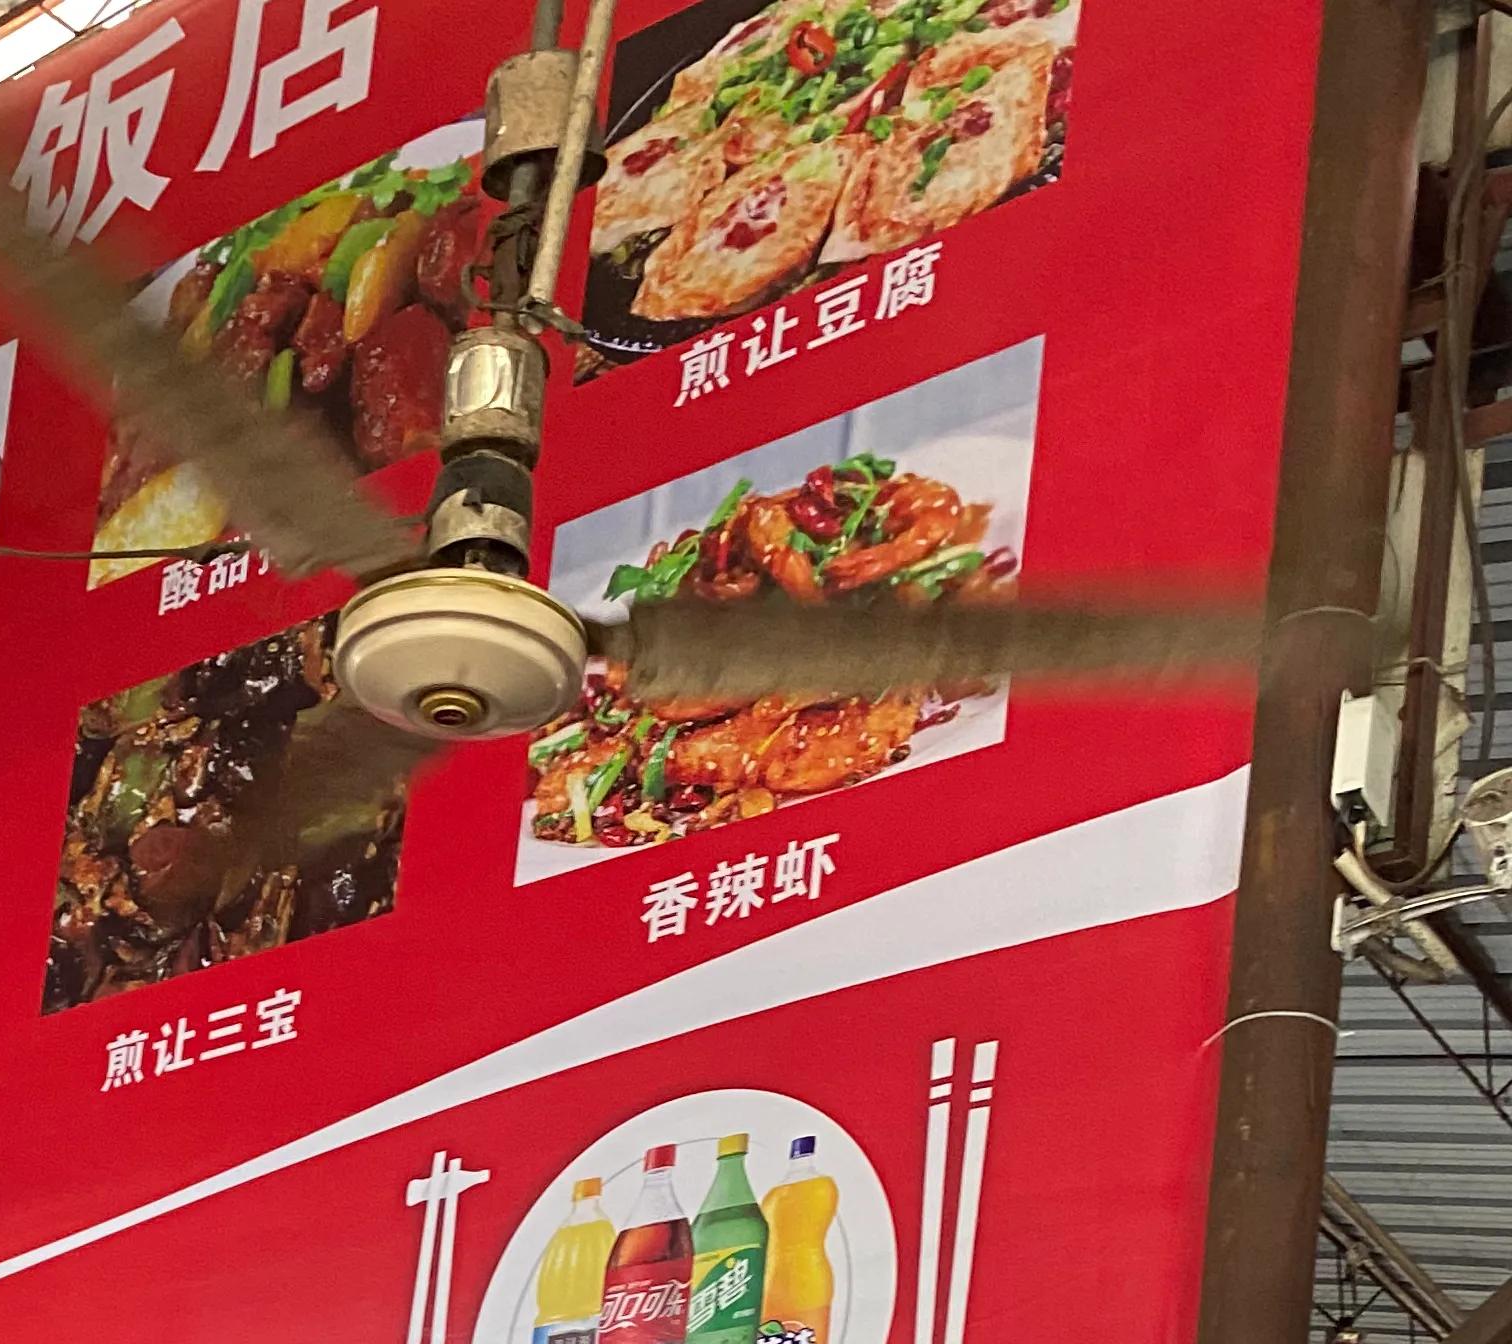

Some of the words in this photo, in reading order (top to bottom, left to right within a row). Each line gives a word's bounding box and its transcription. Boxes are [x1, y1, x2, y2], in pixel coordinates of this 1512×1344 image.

[672, 241, 945, 408] 煎让豆腐
[639, 833, 841, 942] 香辣虾
[100, 987, 302, 1092] 煎让三宝
[599, 1279, 692, 1333] 可口可乐
[687, 1257, 753, 1333] 雪碧
